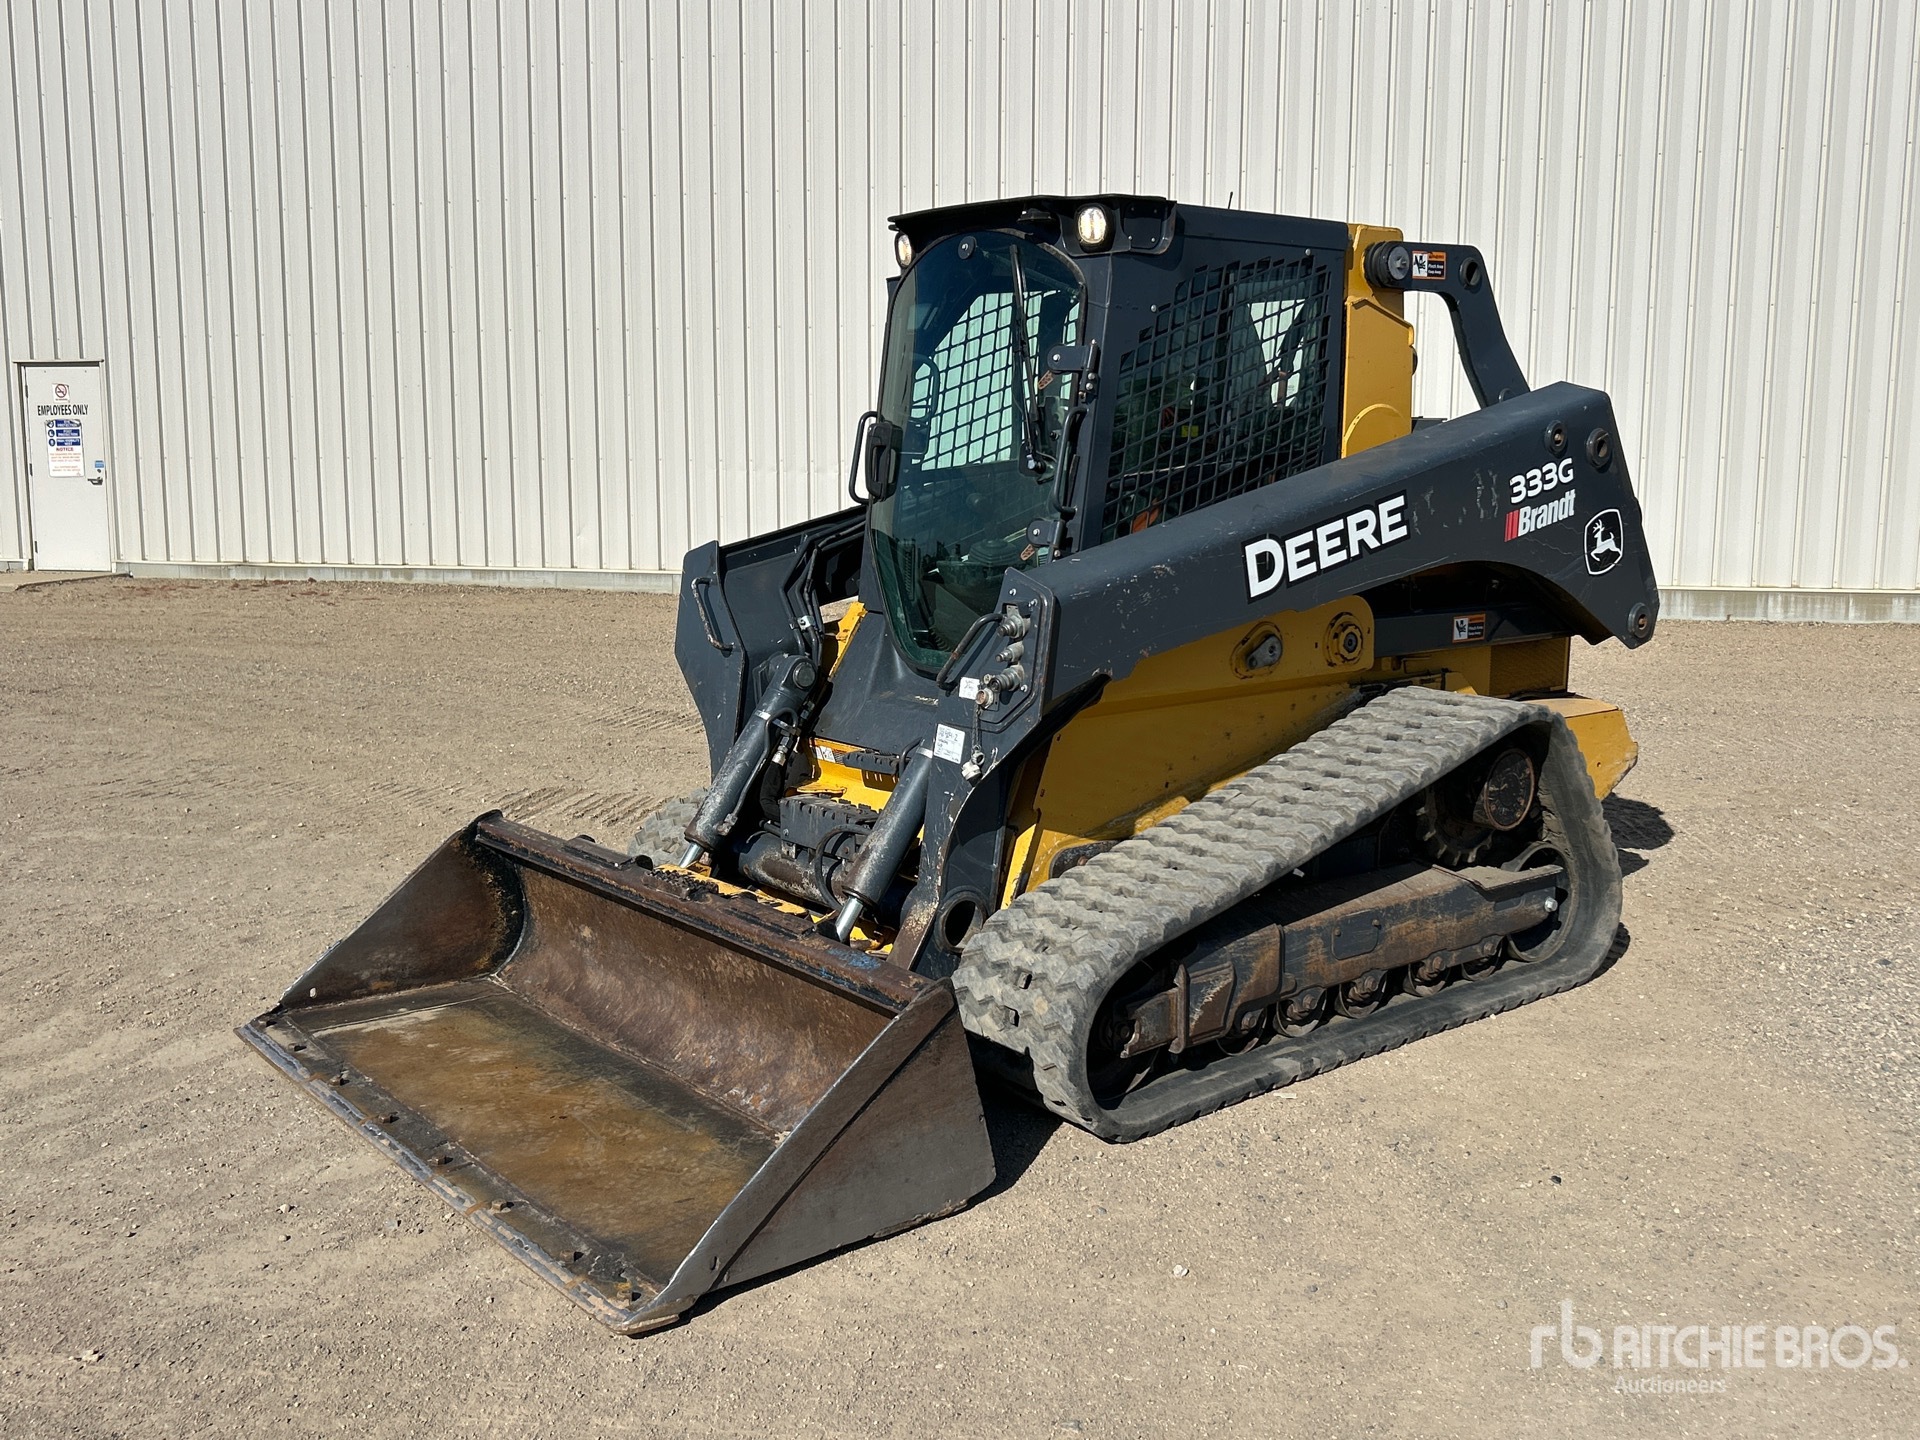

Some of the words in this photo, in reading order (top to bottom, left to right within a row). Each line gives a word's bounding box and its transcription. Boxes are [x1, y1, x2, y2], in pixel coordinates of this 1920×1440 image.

[37, 404, 71, 416] EMPLOYEES
[72, 404, 88, 415] ONLY
[1509, 458, 1574, 504] 333G
[1517, 489, 1576, 537] Brandt
[1245, 495, 1408, 598] DEERE
